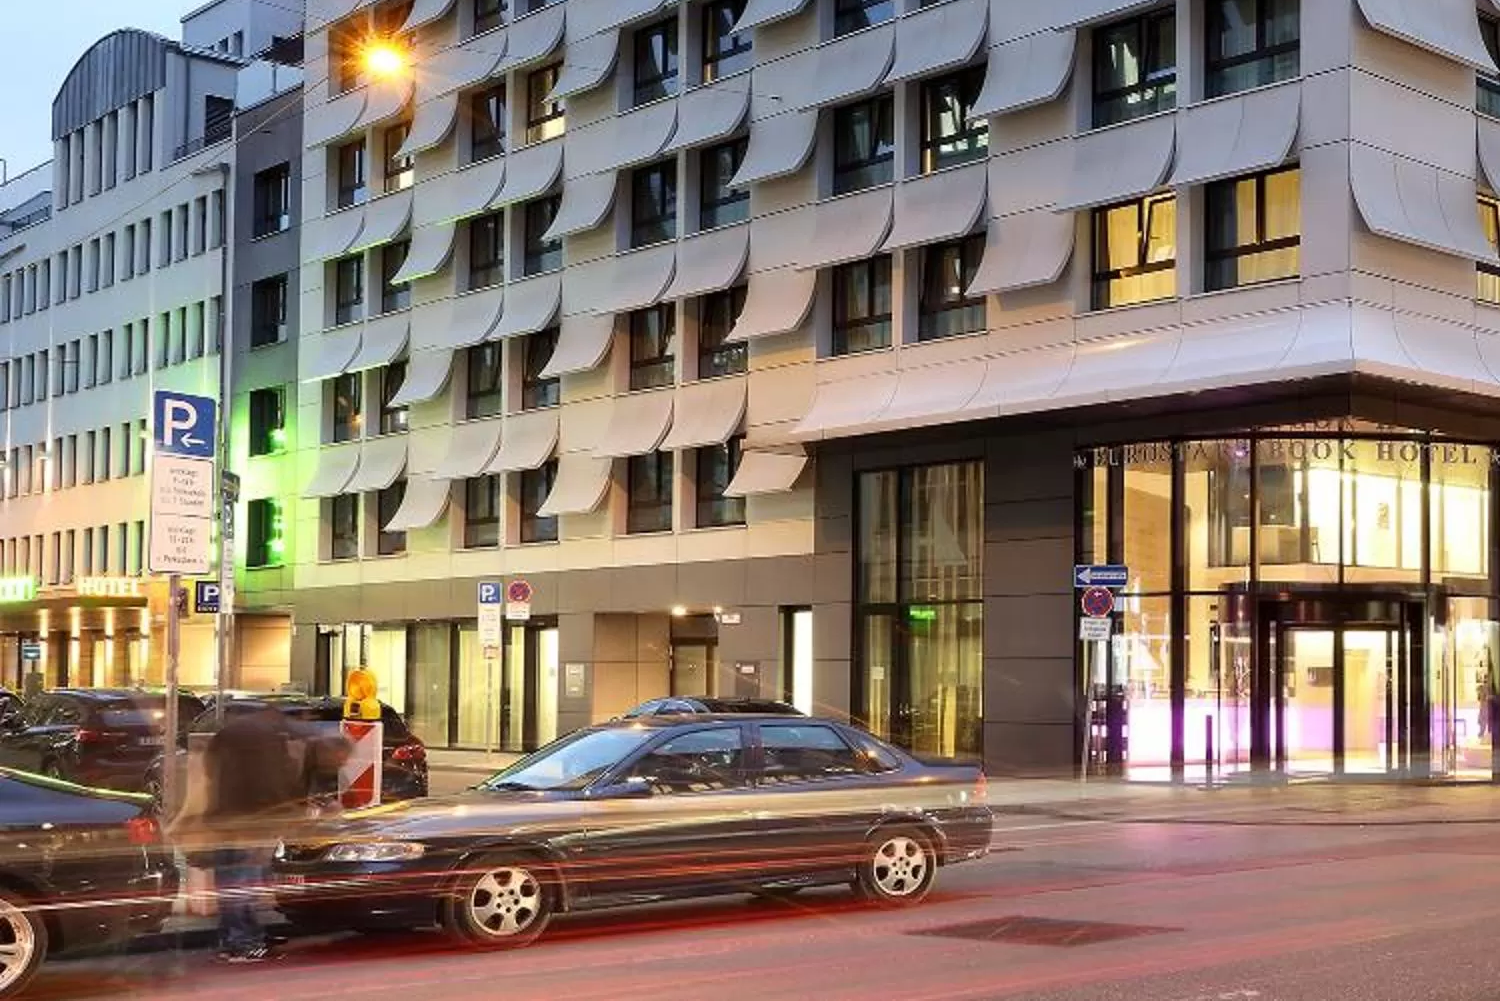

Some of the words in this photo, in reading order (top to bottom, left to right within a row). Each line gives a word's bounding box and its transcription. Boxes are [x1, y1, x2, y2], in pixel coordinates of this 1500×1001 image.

[163, 399, 197, 446] P
[1269, 440, 1356, 462] BOOK
[1376, 441, 1476, 465] HOTEL
[204, 584, 219, 602] P
[481, 584, 495, 602] P
